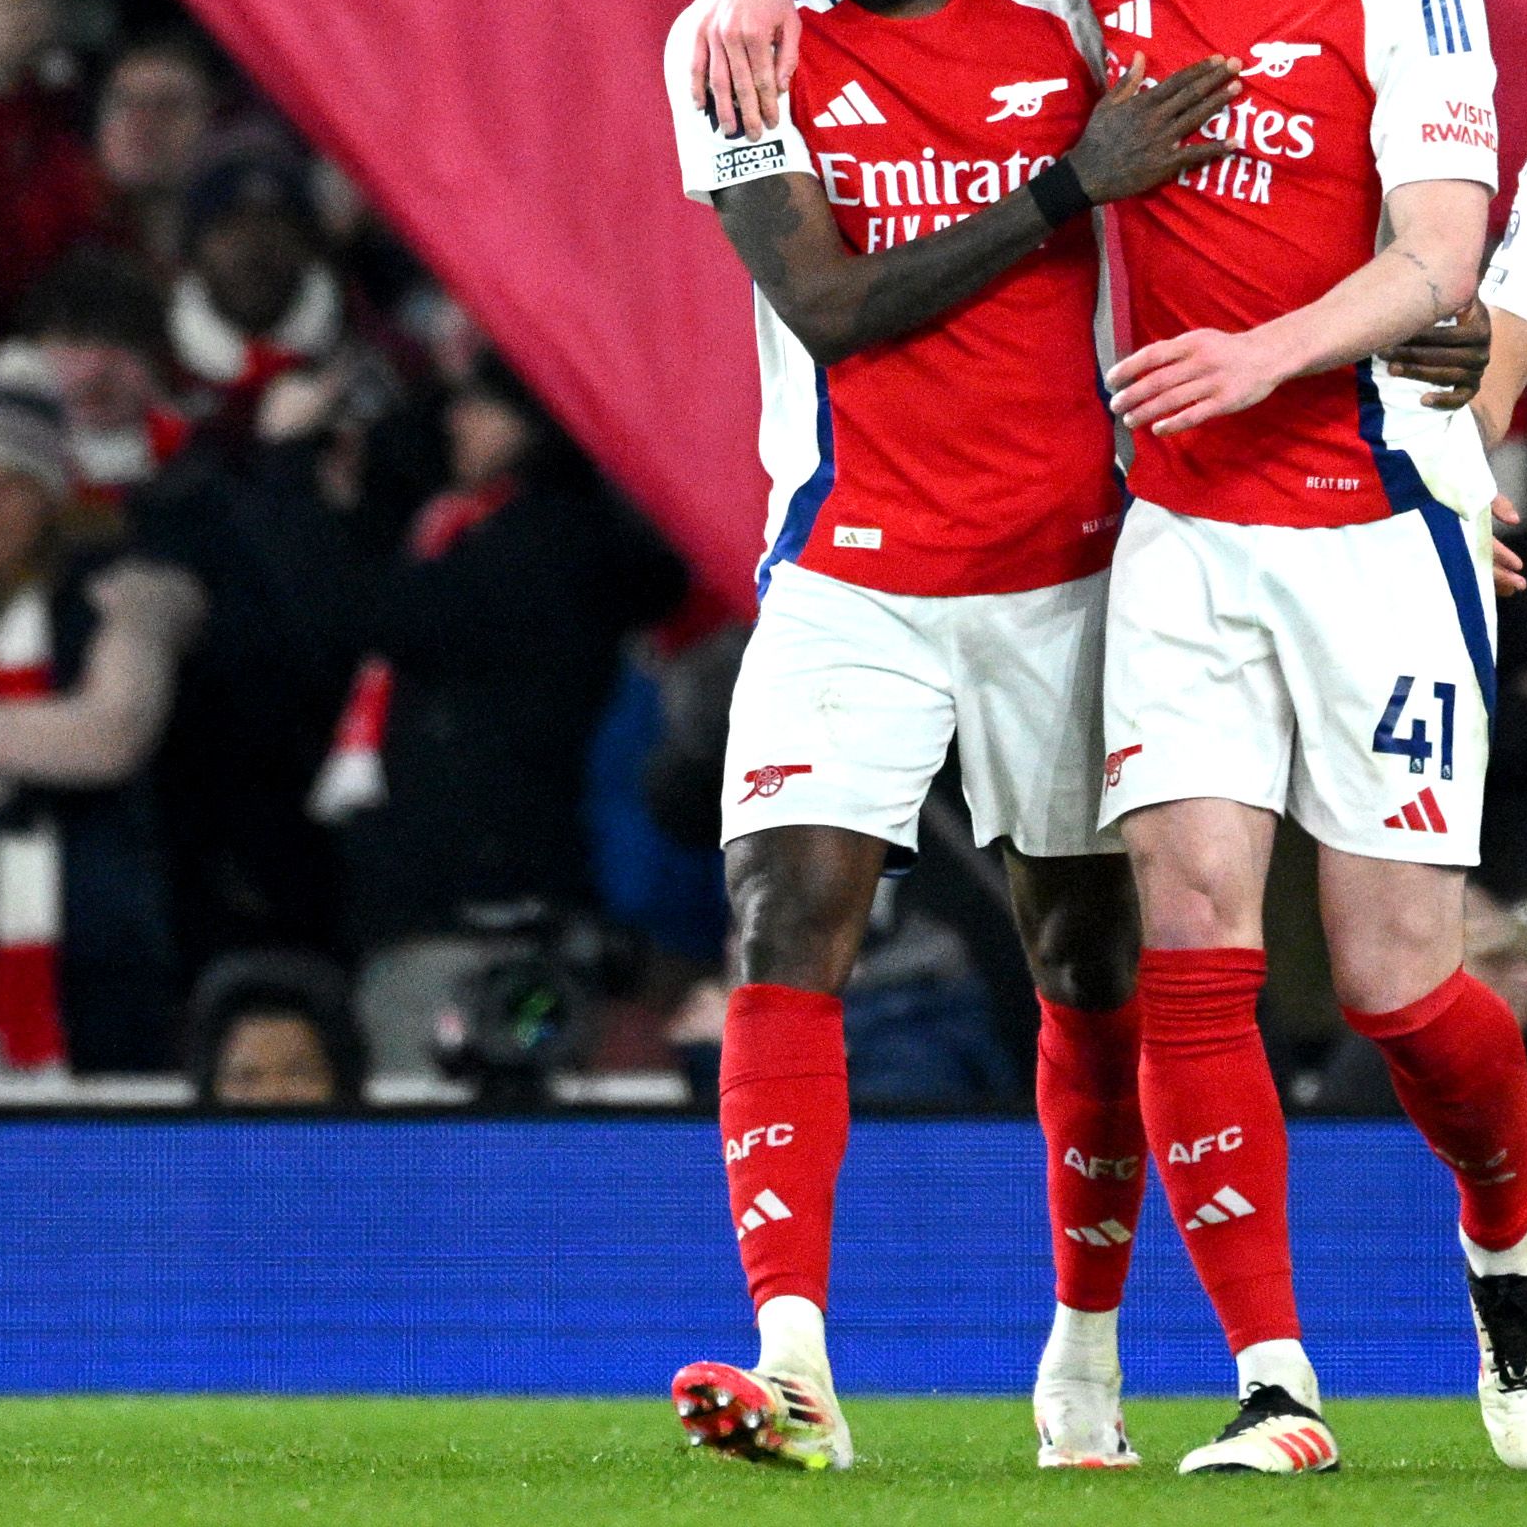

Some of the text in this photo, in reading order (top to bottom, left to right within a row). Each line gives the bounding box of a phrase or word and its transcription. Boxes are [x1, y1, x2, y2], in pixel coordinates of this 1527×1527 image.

[1445, 100, 1492, 128] VISIT
[1421, 123, 1498, 153] RWAND
[714, 144, 778, 170] No room
[817, 147, 1056, 207] Emirat
[1372, 675, 1457, 781] 41
[725, 1123, 795, 1166] AFC
[1064, 1146, 1140, 1180] AFC
[1168, 1125, 1243, 1165] AFC
